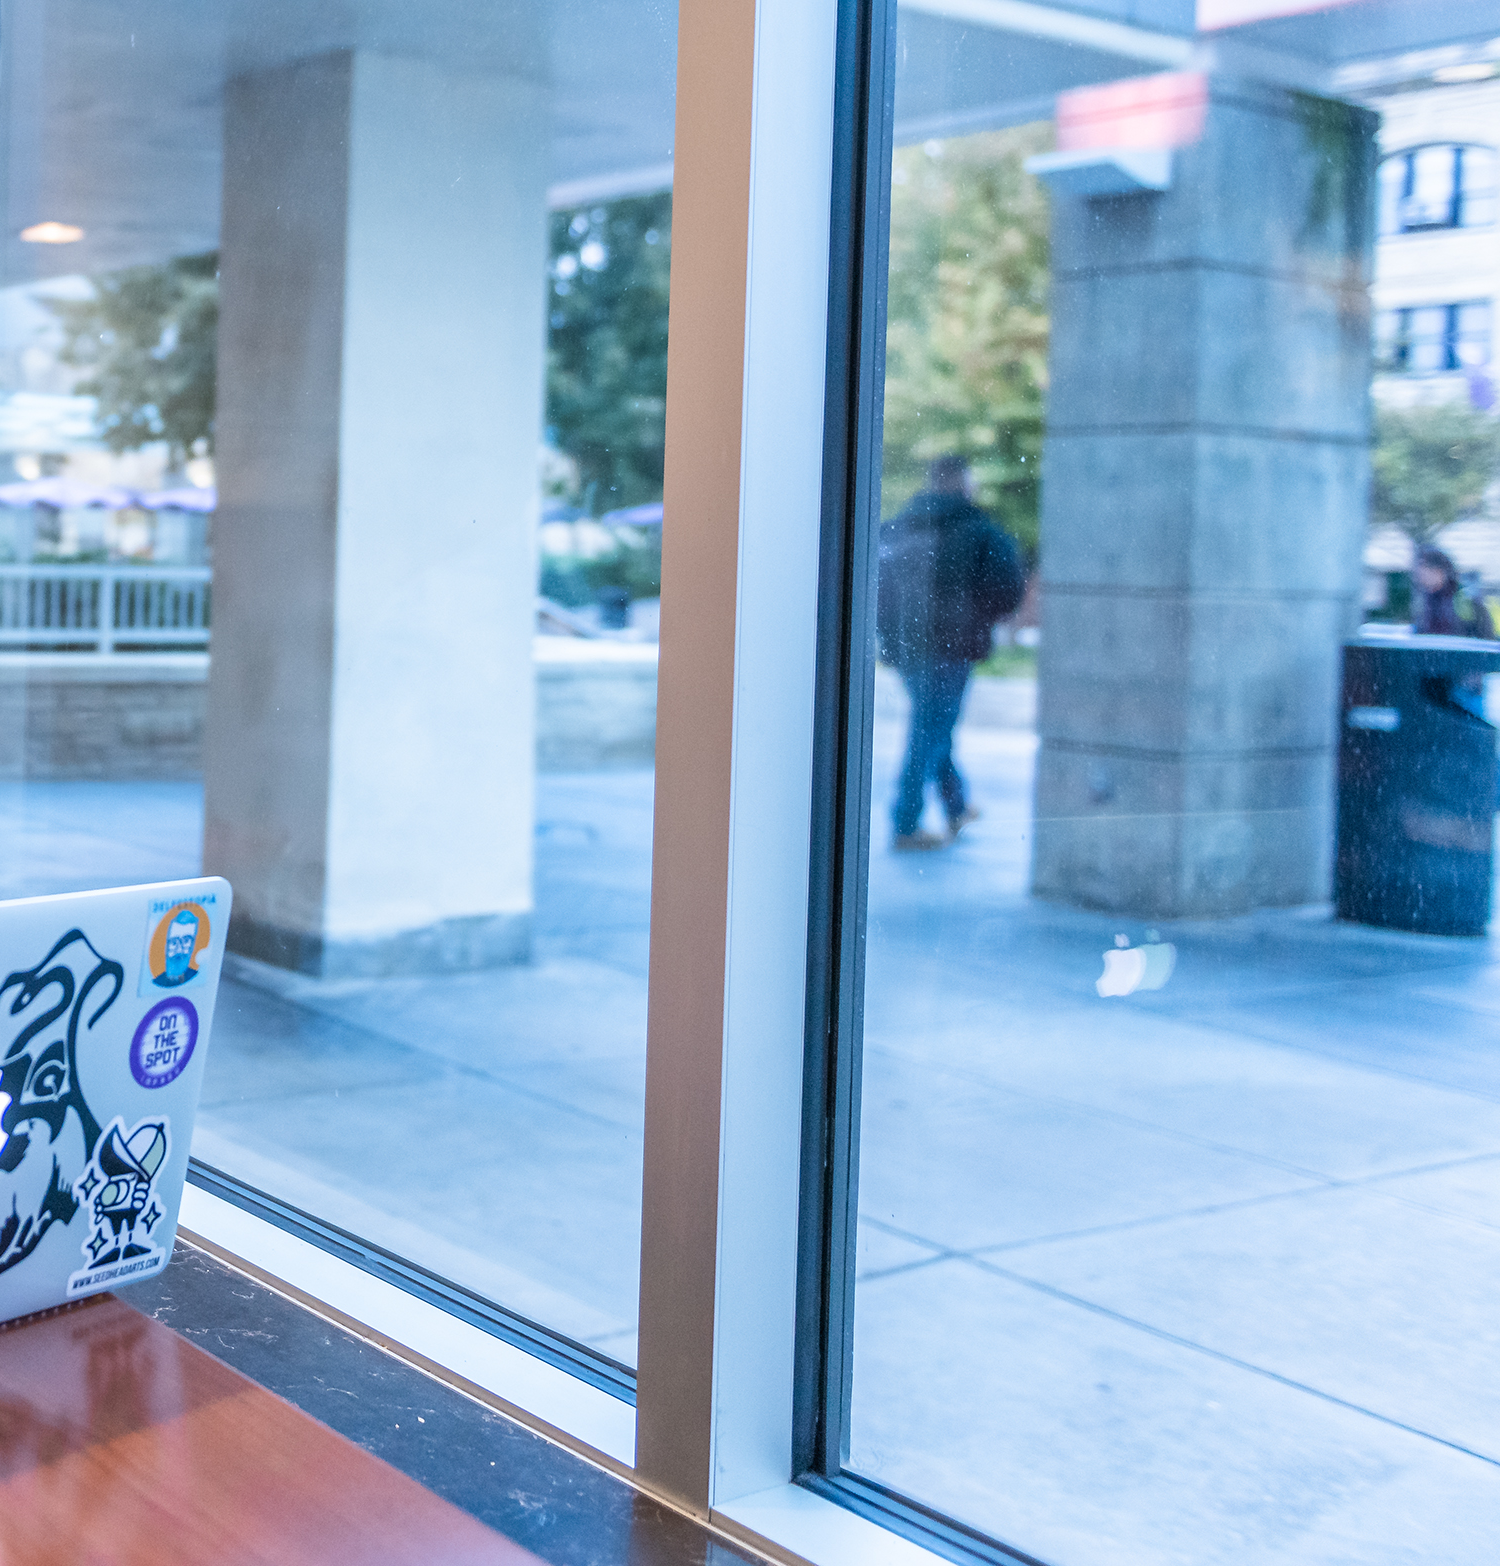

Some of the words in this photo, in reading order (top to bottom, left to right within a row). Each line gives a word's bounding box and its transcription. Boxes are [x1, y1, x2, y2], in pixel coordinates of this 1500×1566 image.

[159, 1014, 177, 1031] ON
[154, 1030, 179, 1049] THE
[145, 1047, 181, 1068] SPOT
